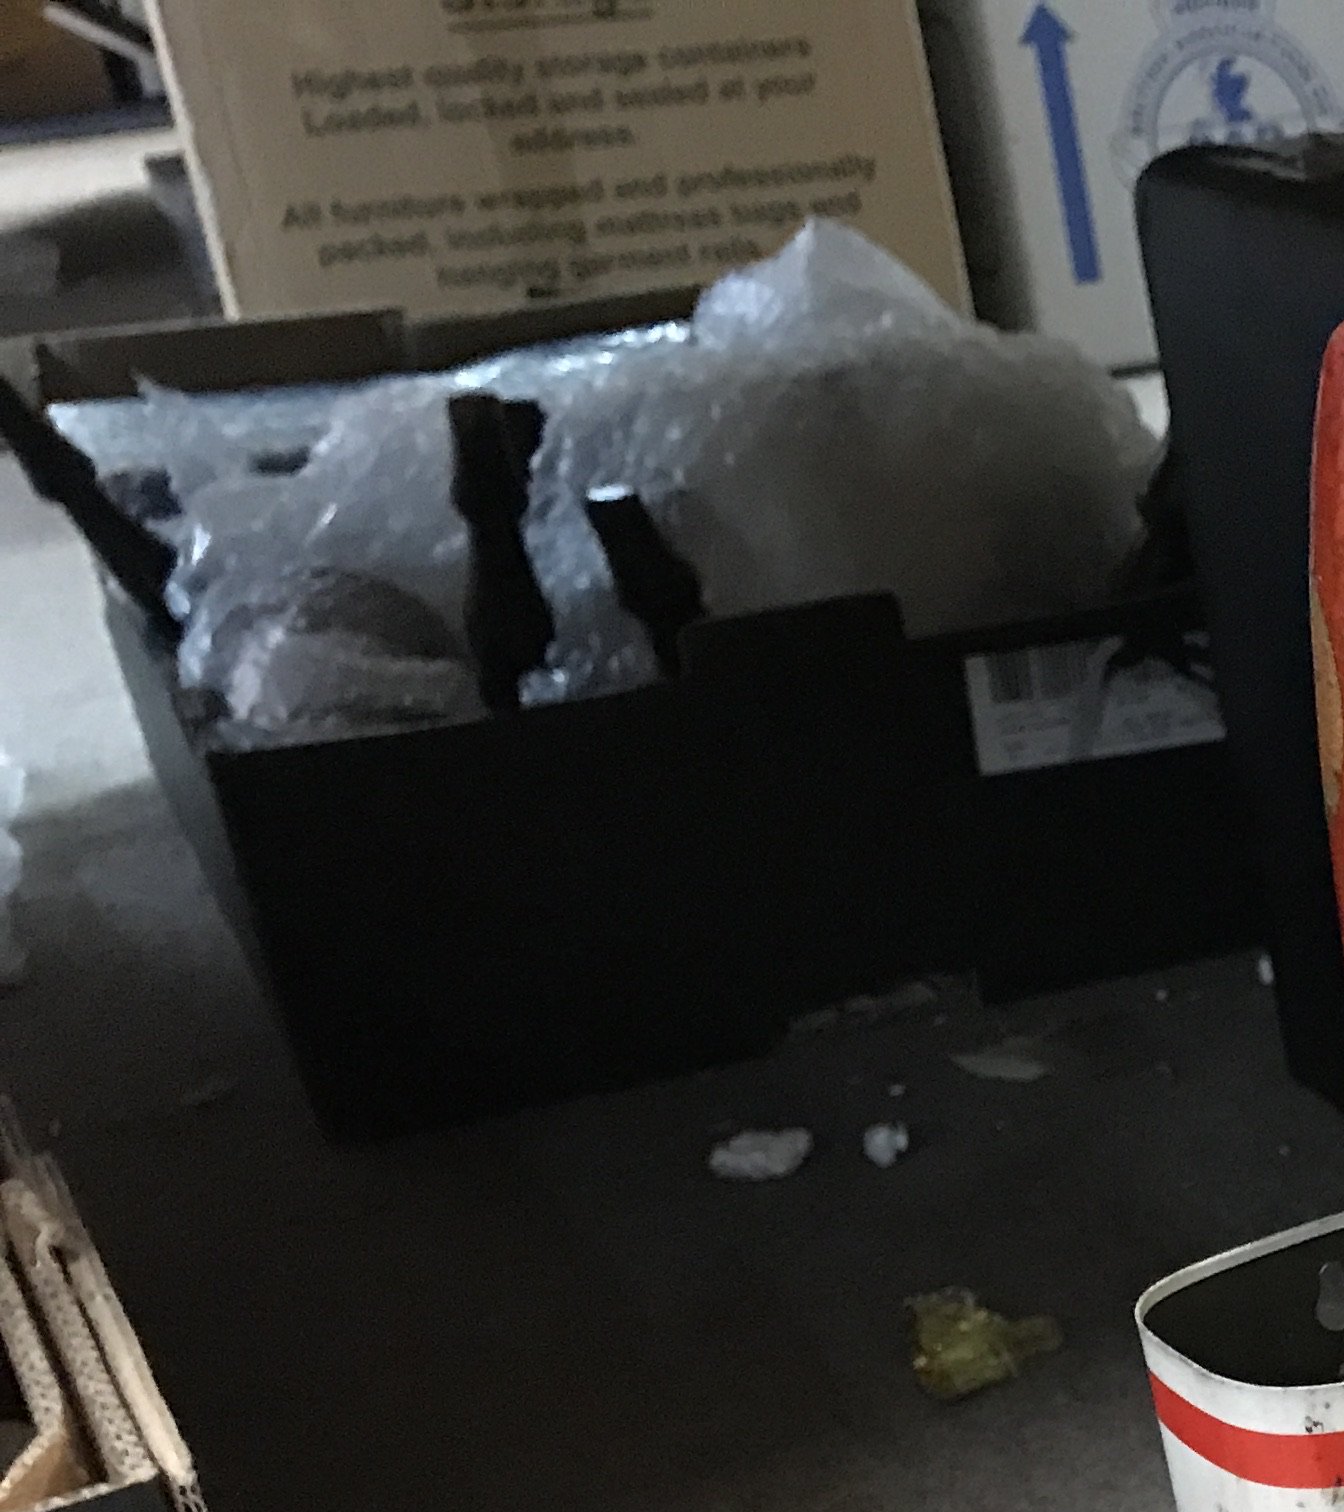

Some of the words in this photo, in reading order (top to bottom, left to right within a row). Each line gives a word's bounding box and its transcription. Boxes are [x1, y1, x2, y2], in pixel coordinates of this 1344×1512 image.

[291, 64, 414, 100] Highest
[422, 55, 526, 90] quality
[534, 52, 648, 82] storage
[656, 38, 812, 72] containers
[545, 87, 604, 116] and
[718, 77, 745, 99] at
[756, 72, 816, 104] your
[281, 200, 321, 231] All
[329, 193, 467, 226] furniture
[474, 178, 605, 214] wrapped
[613, 170, 668, 198] and
[676, 153, 877, 199] professionally
[808, 187, 863, 216] and
